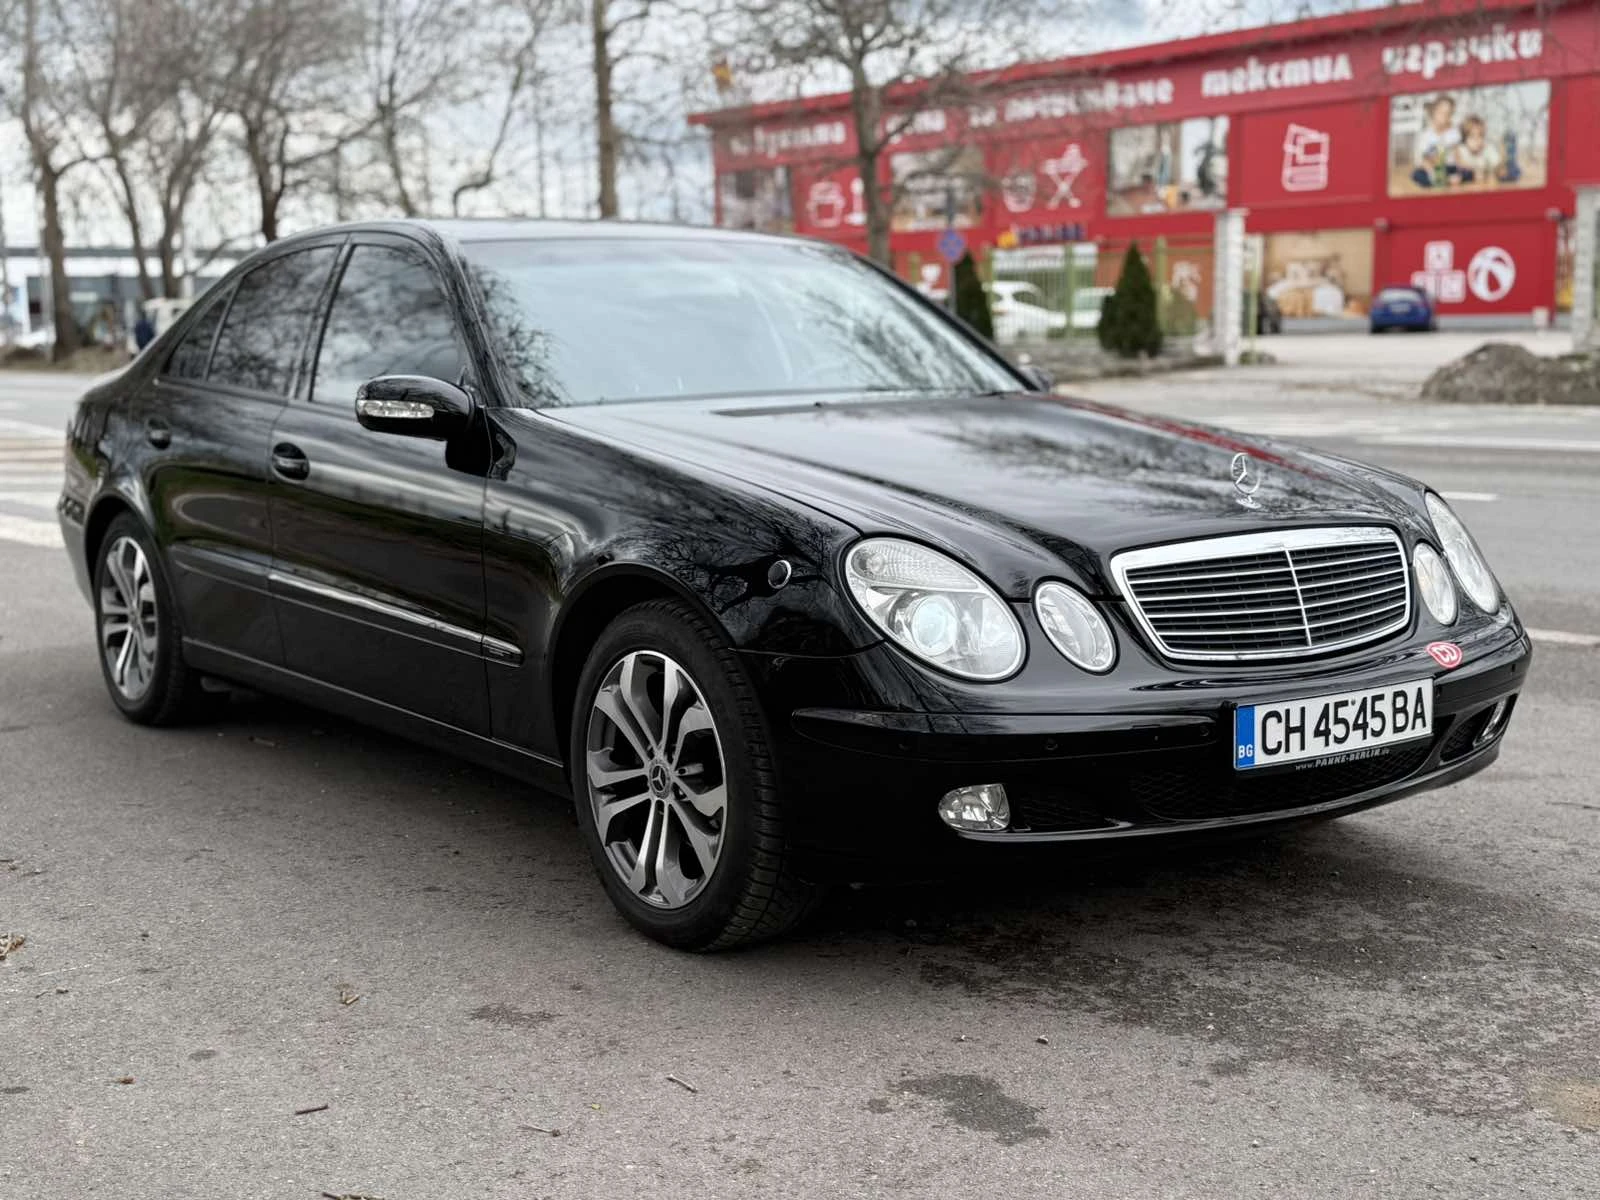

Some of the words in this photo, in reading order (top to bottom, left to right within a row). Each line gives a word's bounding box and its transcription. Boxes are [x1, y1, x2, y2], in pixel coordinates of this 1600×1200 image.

[1201, 54, 1352, 97] текстил
[1382, 24, 1543, 79] играчки
[1261, 706, 1306, 756] CH
[1313, 693, 1386, 748] 4545
[1392, 687, 1427, 735] BA
[1238, 744, 1254, 759] BG
